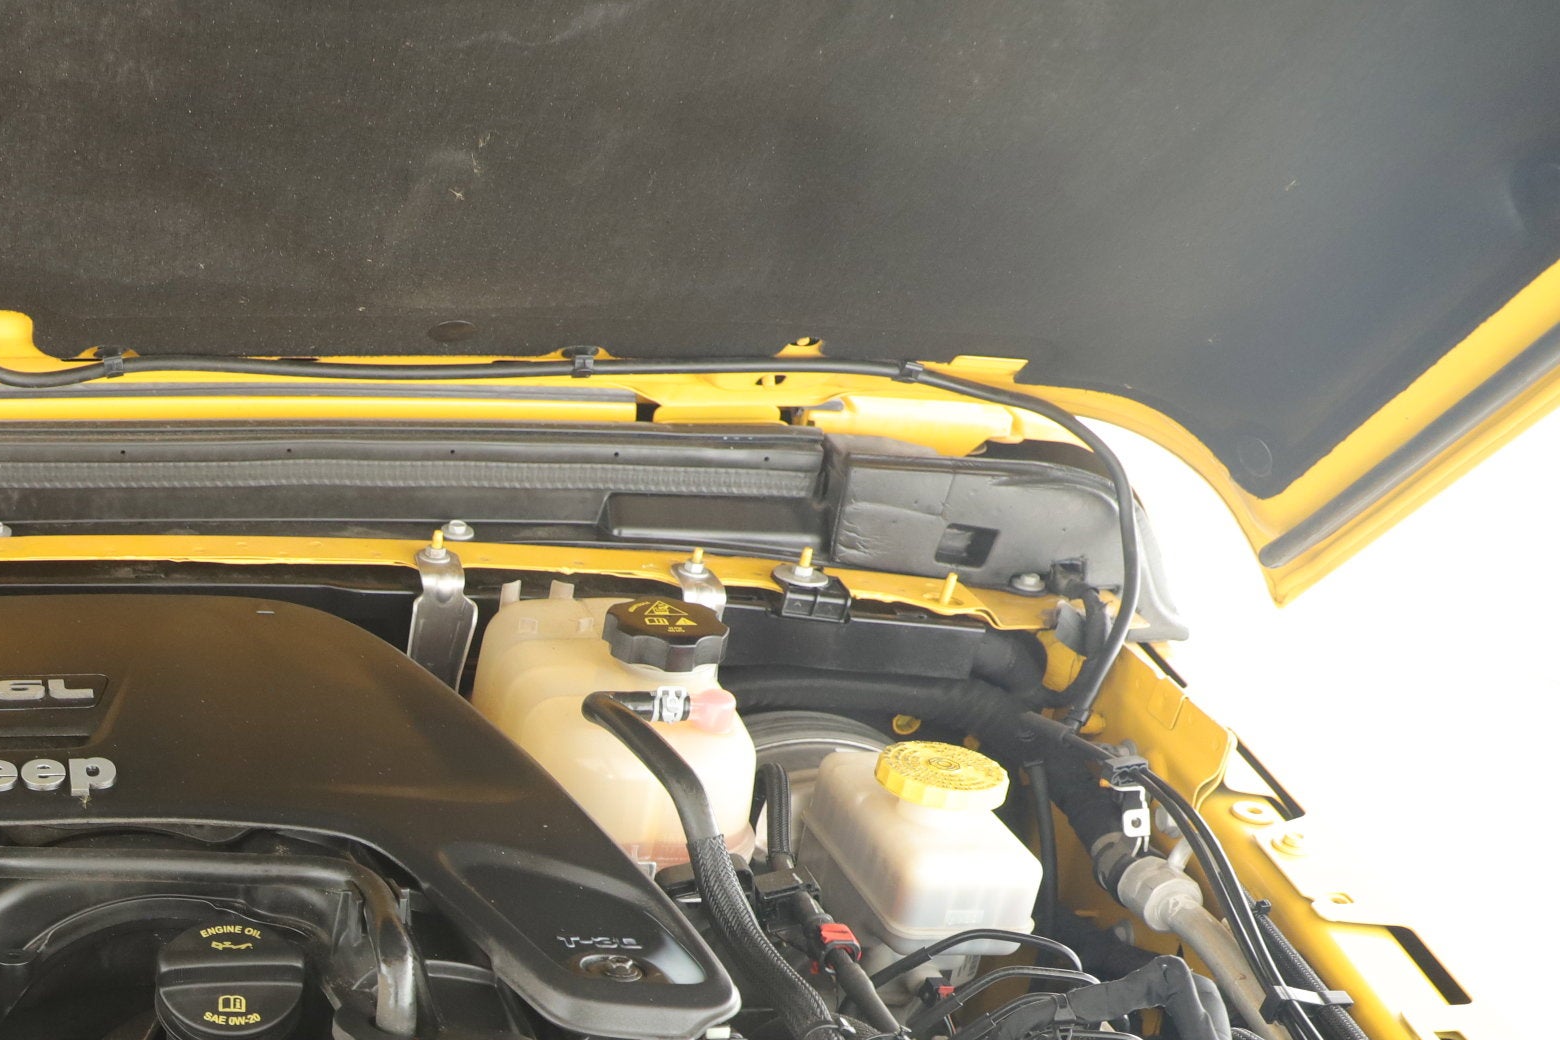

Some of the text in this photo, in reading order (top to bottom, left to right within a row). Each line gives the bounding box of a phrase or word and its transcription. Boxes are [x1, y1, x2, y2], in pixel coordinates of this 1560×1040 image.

[200, 925, 262, 939] ENGINE OIL
[203, 1011, 261, 1026] SAE 0W-20
